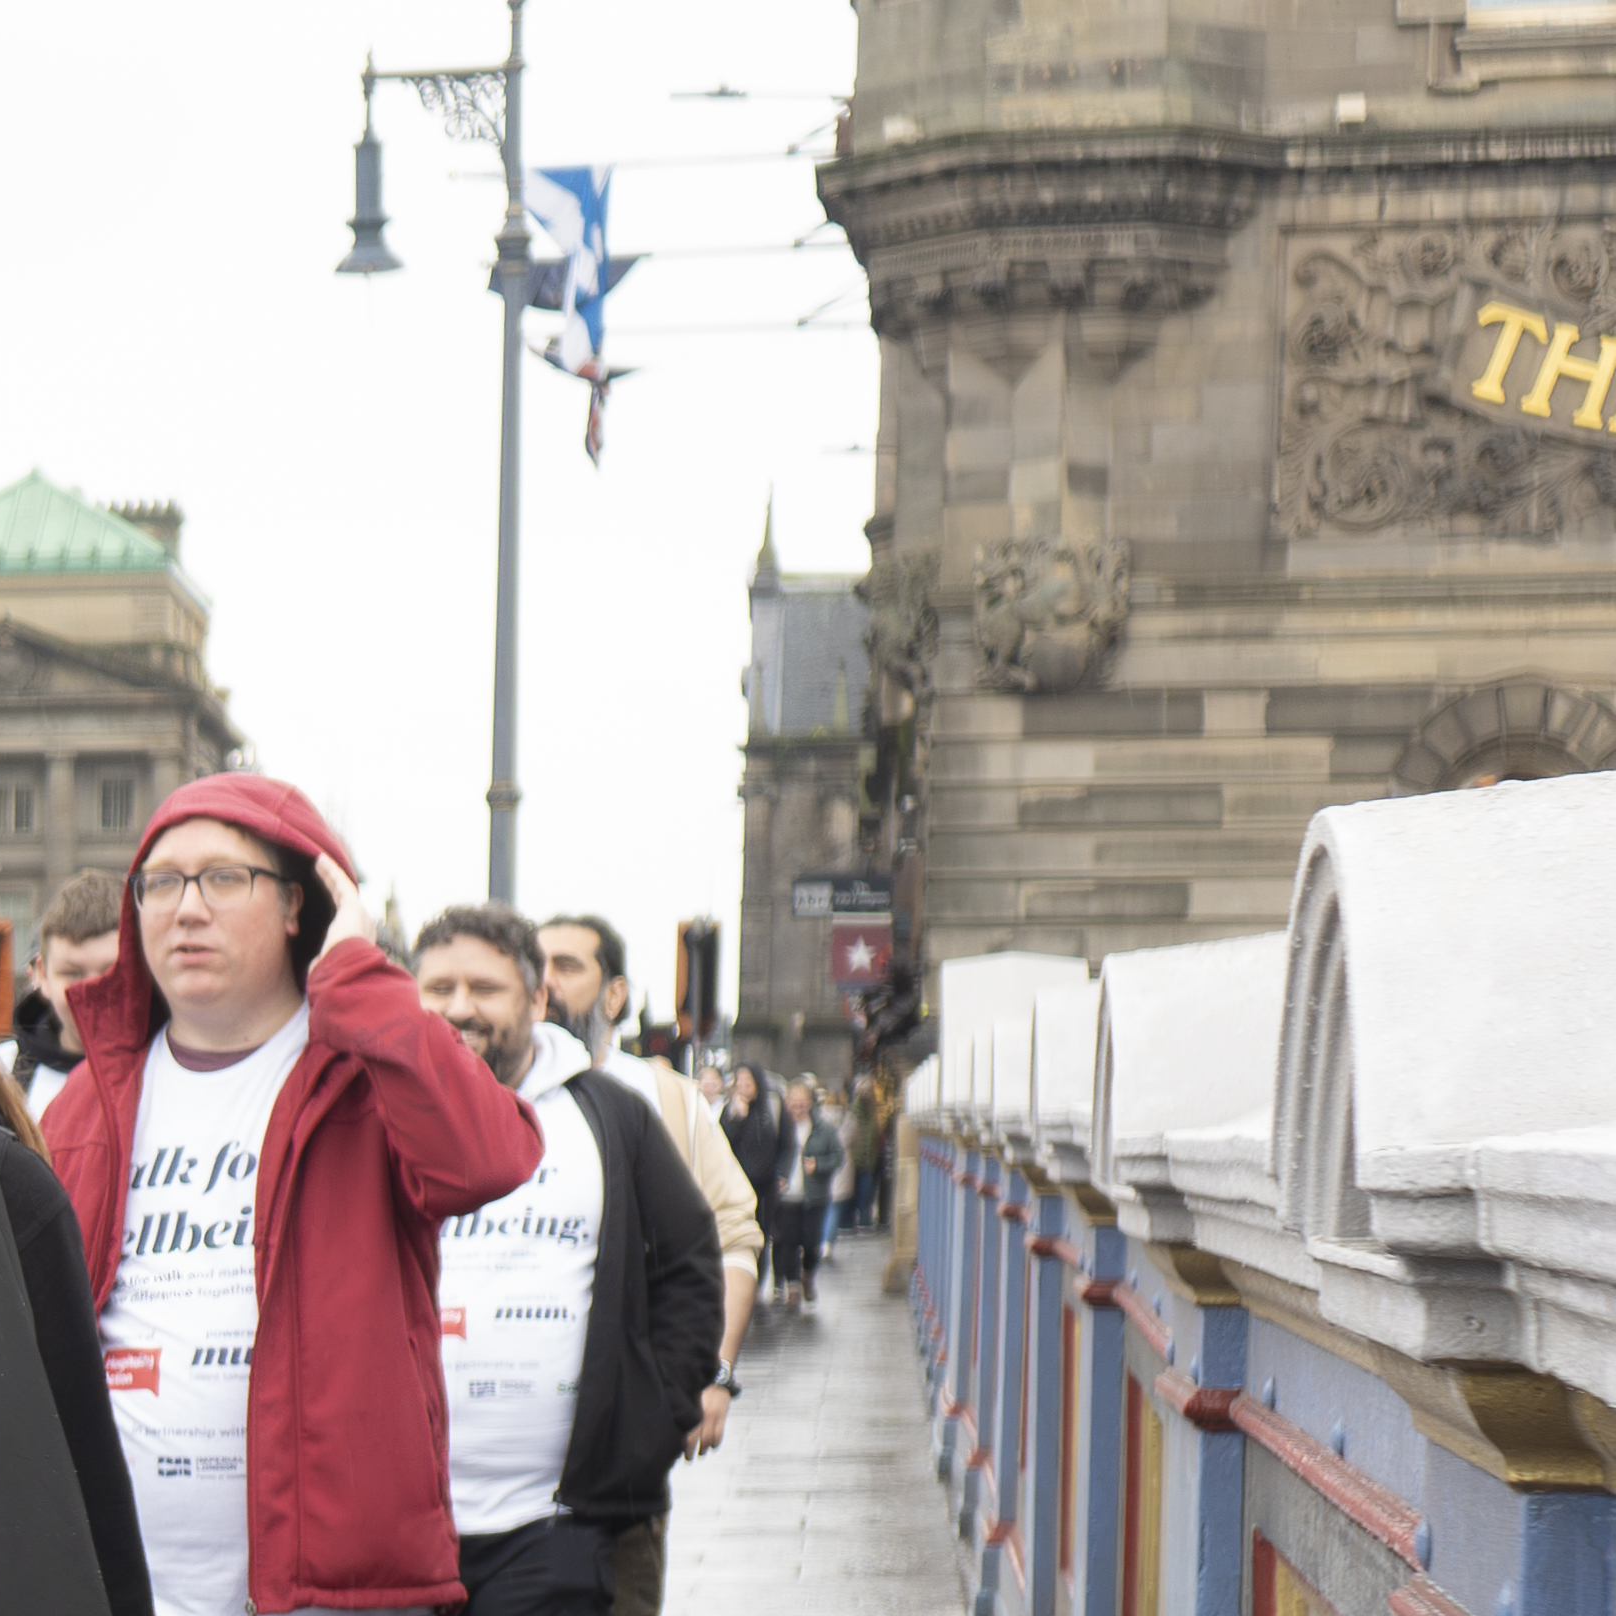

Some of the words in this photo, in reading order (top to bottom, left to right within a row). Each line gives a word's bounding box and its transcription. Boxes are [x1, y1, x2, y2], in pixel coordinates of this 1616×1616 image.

[1472, 301, 1616, 433] TH
[202, 1139, 257, 1196] fo
[198, 1282, 255, 1299] togethe
[206, 1329, 254, 1341] powere
